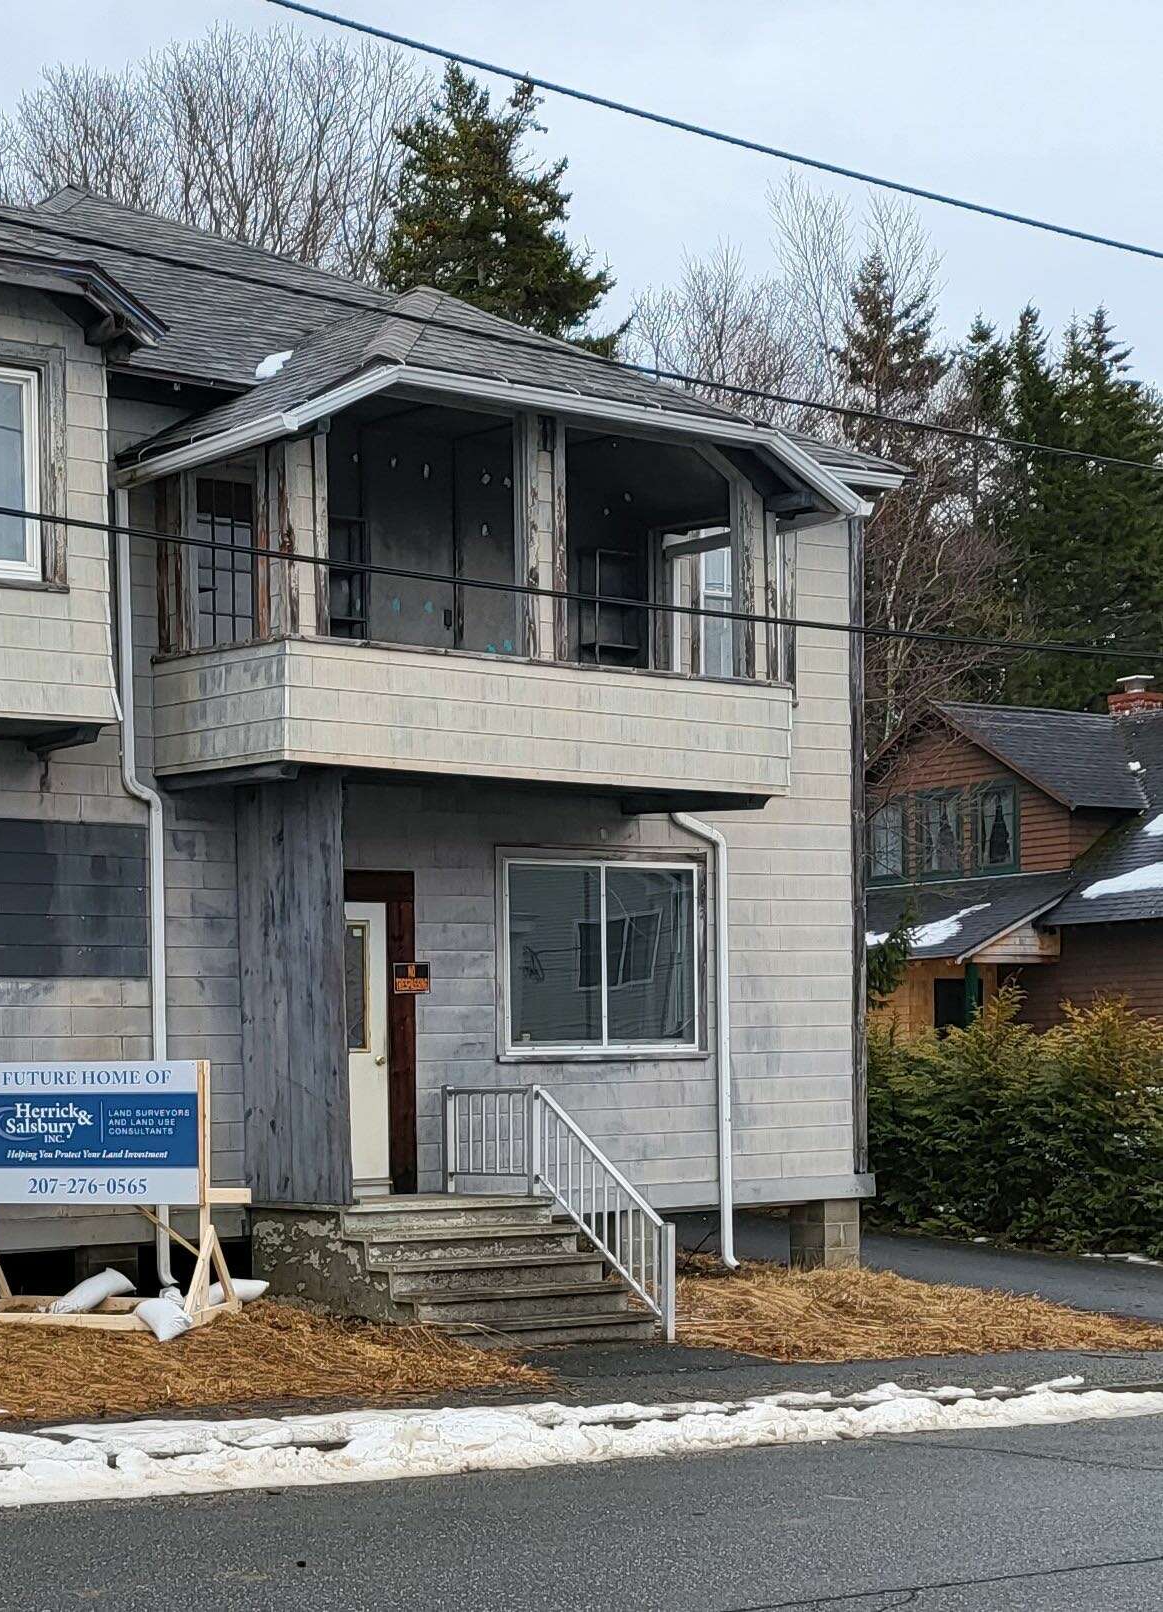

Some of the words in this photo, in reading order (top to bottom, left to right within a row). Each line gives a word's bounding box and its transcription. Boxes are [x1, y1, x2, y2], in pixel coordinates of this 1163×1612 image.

[2, 1071, 77, 1085] FUTURE
[82, 1070, 140, 1085] HOME
[145, 1069, 172, 1084] OF
[15, 1102, 79, 1118] Herrick
[77, 1110, 94, 1126] &
[108, 1109, 132, 1117] LAND
[135, 1109, 190, 1117] SURVEYORS
[5, 1117, 76, 1139] Salsbury
[108, 1118, 127, 1126] AND
[130, 1118, 154, 1126] LAND
[157, 1118, 176, 1126] USE
[108, 1127, 174, 1135] CONSULTANTS
[44, 1135, 65, 1143] INC.
[6, 1149, 38, 1161] Helping
[39, 1150, 53, 1158] You
[54, 1149, 81, 1158] Protect
[83, 1149, 101, 1158] Your
[101, 1149, 123, 1158] Land
[124, 1149, 169, 1159] Investment
[27, 1177, 147, 1194] 207-276-0565
